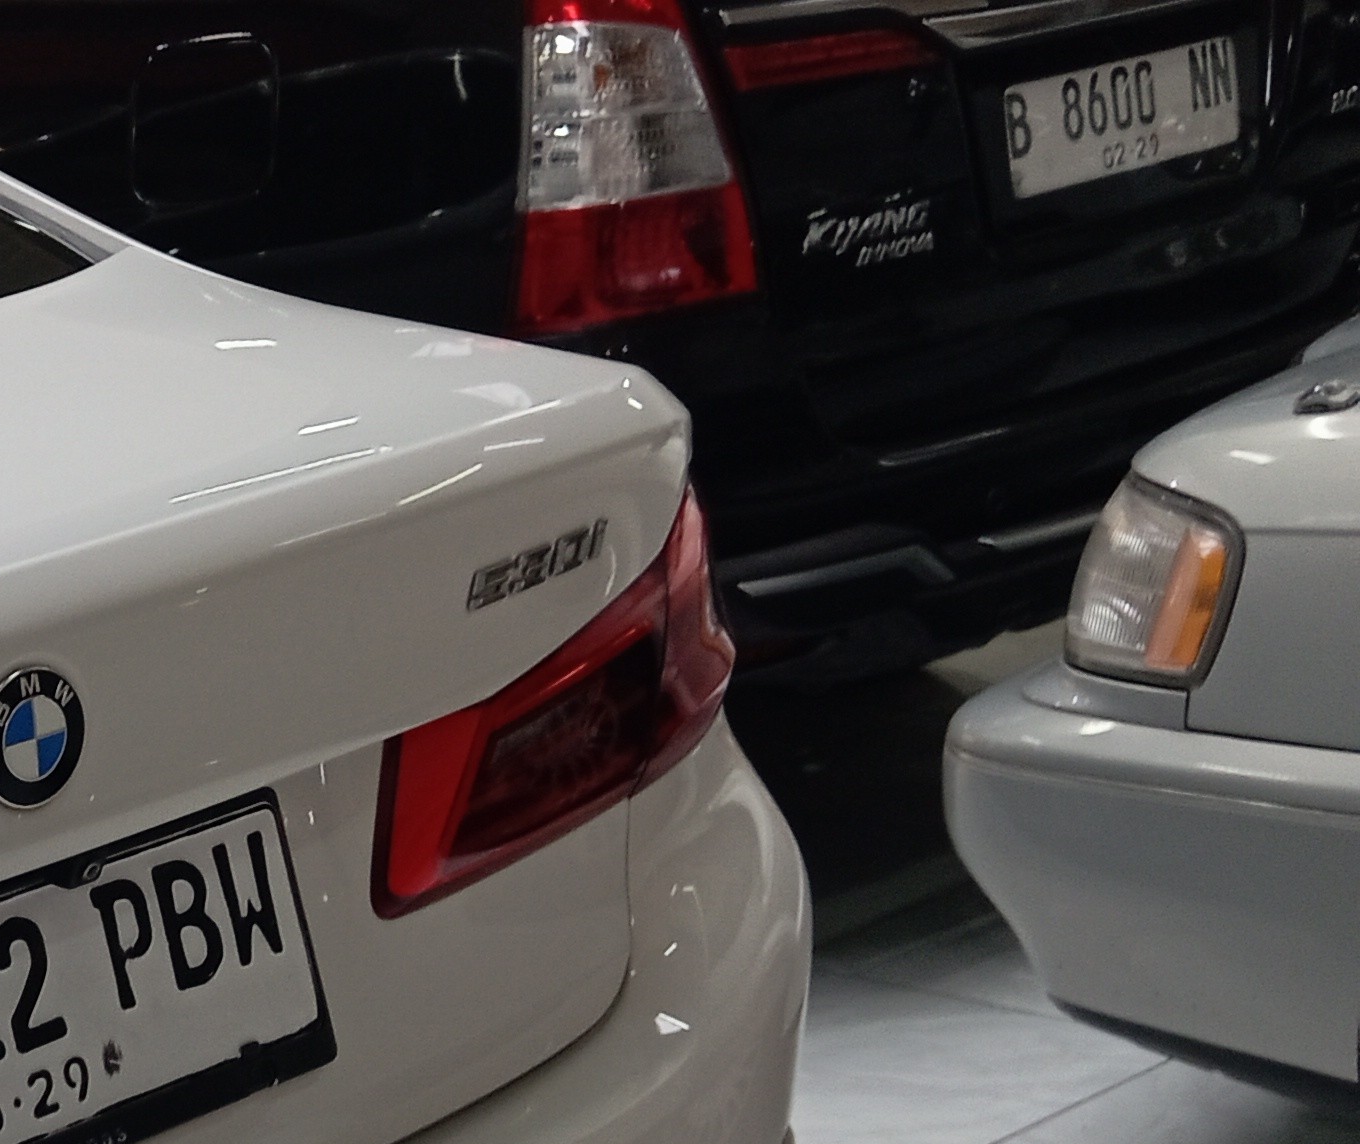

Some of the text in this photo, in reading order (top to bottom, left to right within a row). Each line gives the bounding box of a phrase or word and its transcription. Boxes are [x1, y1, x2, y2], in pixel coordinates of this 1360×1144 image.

[1005, 38, 1233, 160] B 8600 NN
[89, 830, 284, 1010] PBW
